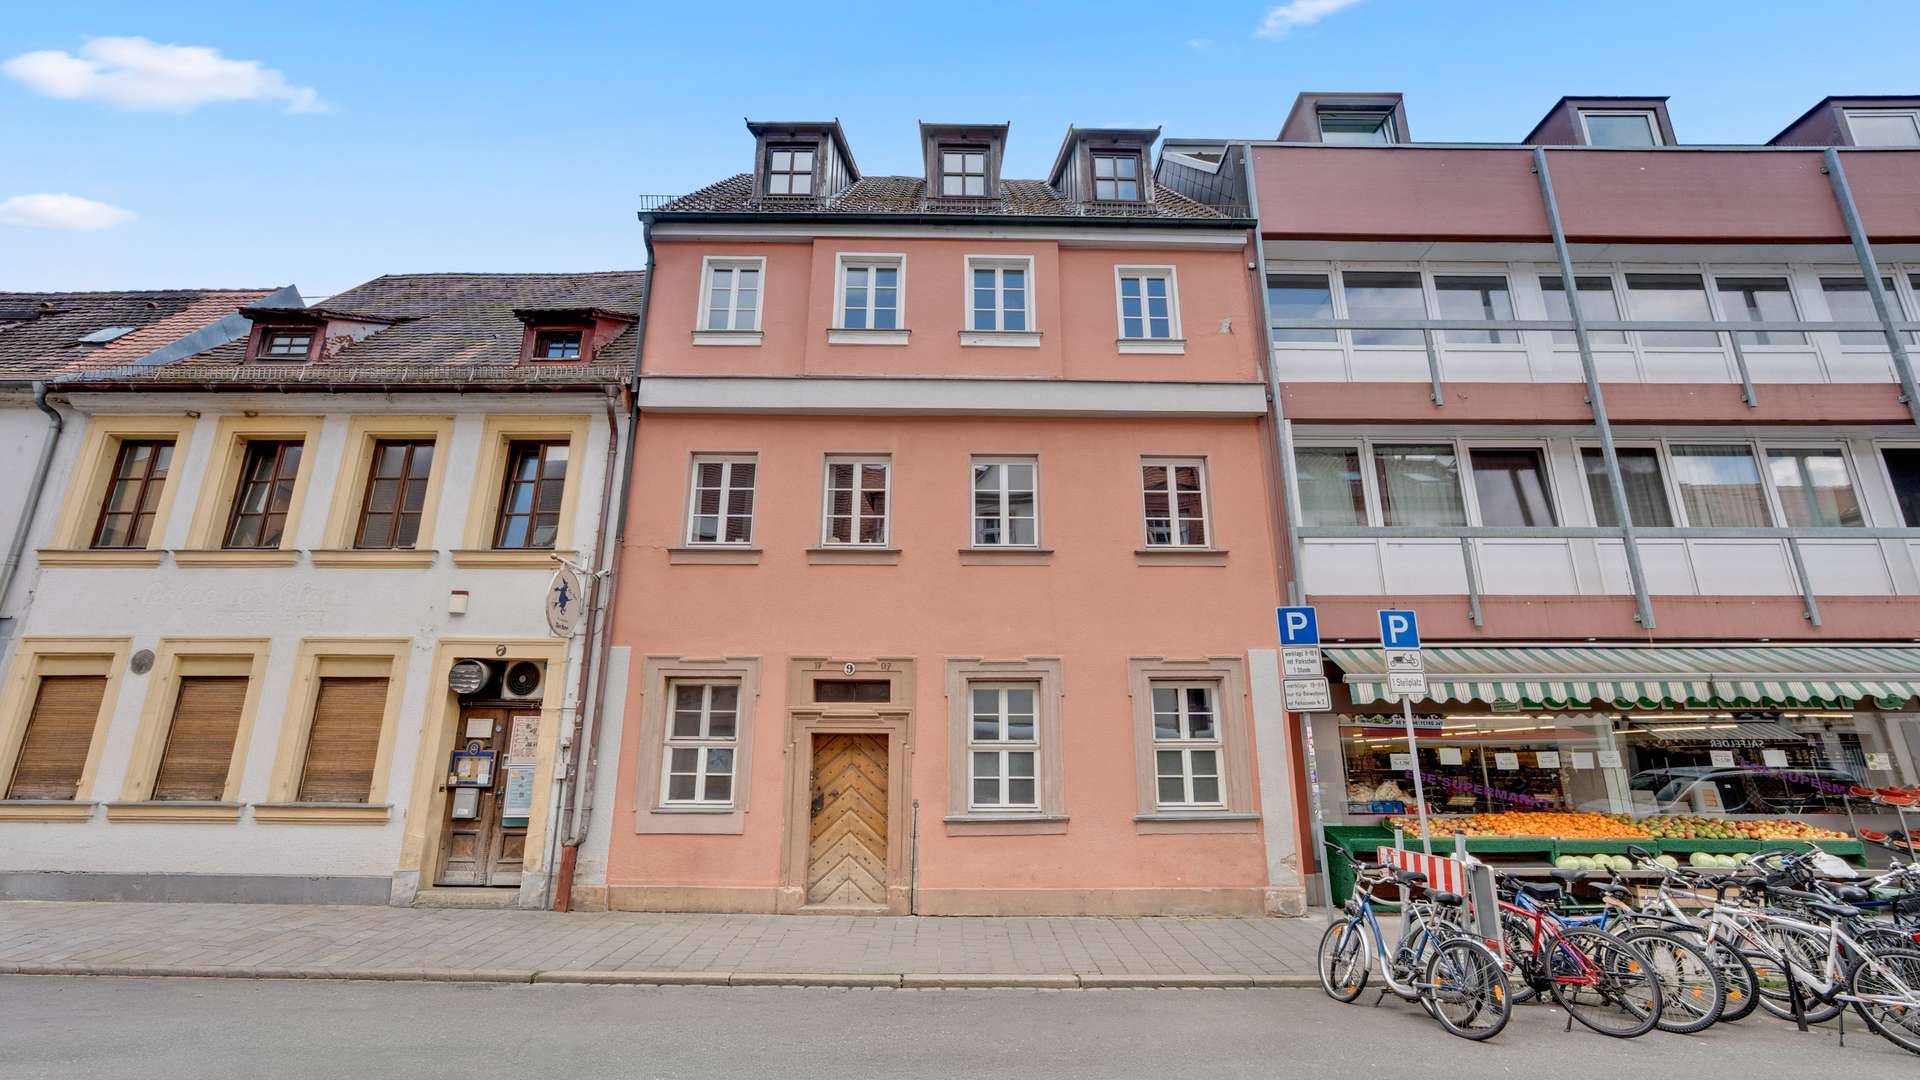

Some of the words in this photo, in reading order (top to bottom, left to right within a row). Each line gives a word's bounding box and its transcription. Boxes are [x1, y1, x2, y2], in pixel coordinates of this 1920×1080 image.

[1286, 612, 1308, 640] P
[1388, 615, 1409, 643] P
[846, 664, 854, 673] 9
